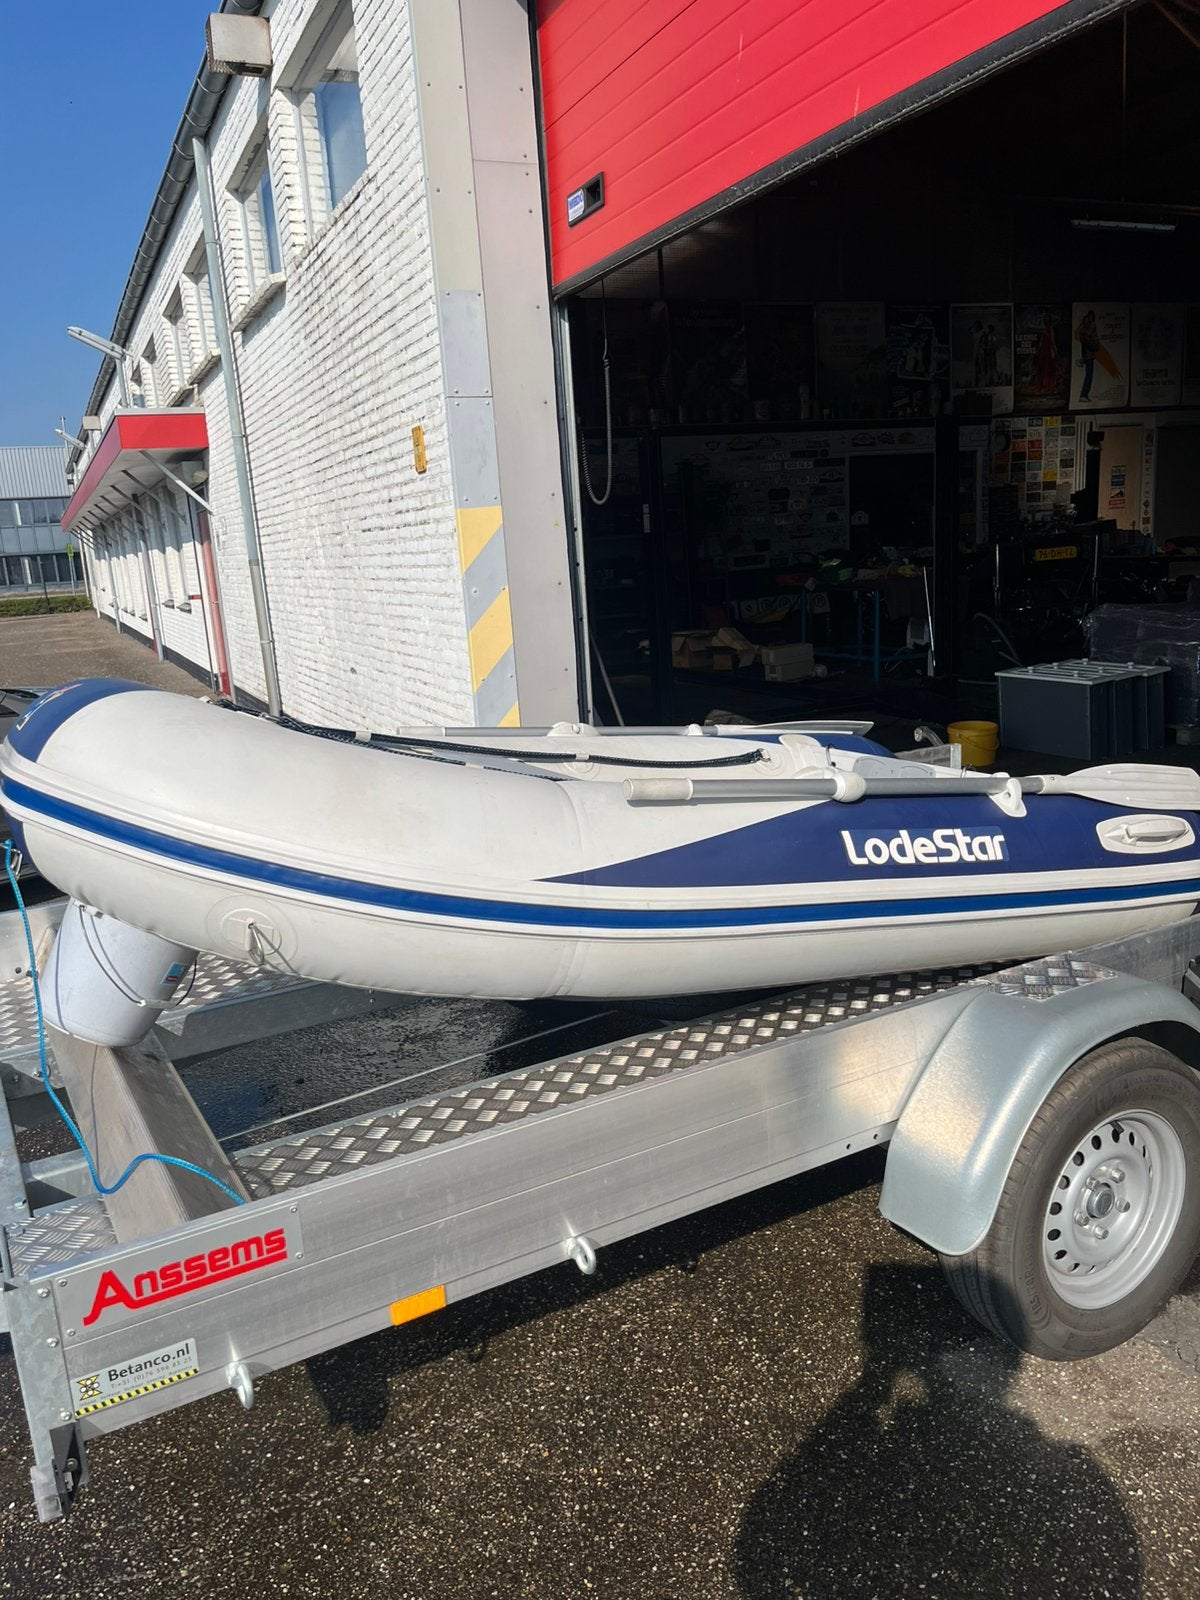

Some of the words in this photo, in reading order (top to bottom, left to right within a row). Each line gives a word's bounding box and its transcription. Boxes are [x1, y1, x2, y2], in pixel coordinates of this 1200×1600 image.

[840, 828, 1005, 865] LodeStar
[83, 1228, 287, 1326] Anssems
[108, 1343, 190, 1382] Betanco.nl
